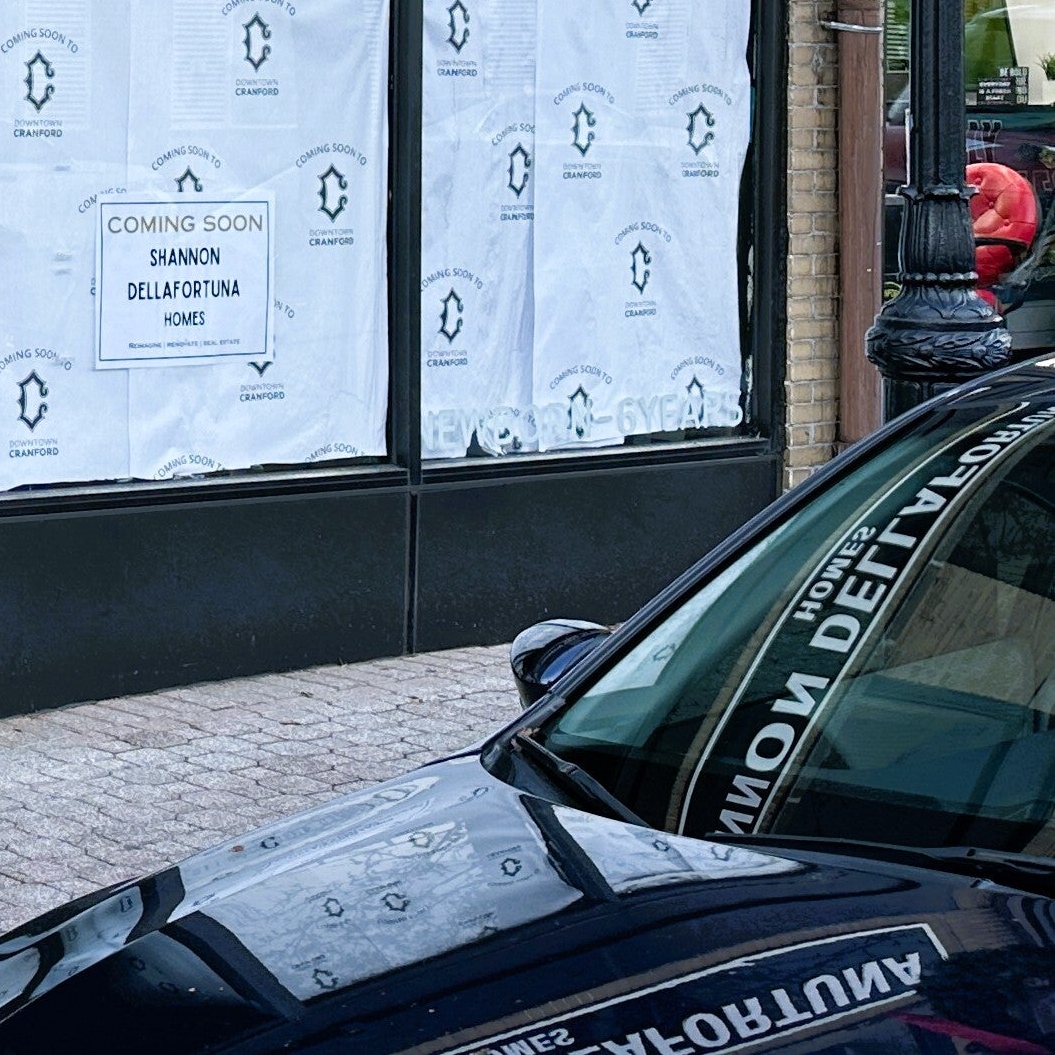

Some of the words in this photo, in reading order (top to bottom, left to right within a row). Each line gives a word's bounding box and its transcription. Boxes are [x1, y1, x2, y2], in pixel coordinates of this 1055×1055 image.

[284, 1, 296, 17] TO
[0, 28, 37, 54] COMING
[39, 28, 66, 44] SOON
[67, 39, 78, 53] TO
[235, 87, 279, 96] CRANFORD
[14, 128, 63, 138] CRANFORD
[151, 146, 186, 171] COMING
[188, 145, 210, 161] SOON
[210, 154, 221, 168] TO
[296, 143, 330, 168] COMING
[332, 143, 358, 158] SOON
[356, 150, 367, 166] TO
[108, 215, 195, 234] COMING
[203, 215, 263, 232] SOON
[308, 237, 354, 246] CRANFORD
[150, 247, 220, 267] SHANNON
[128, 279, 240, 300] DELLAFORTUNA
[164, 311, 205, 327] HOMES
[240, 391, 285, 402] CRANFORD
[9, 448, 59, 458] CRANFORD
